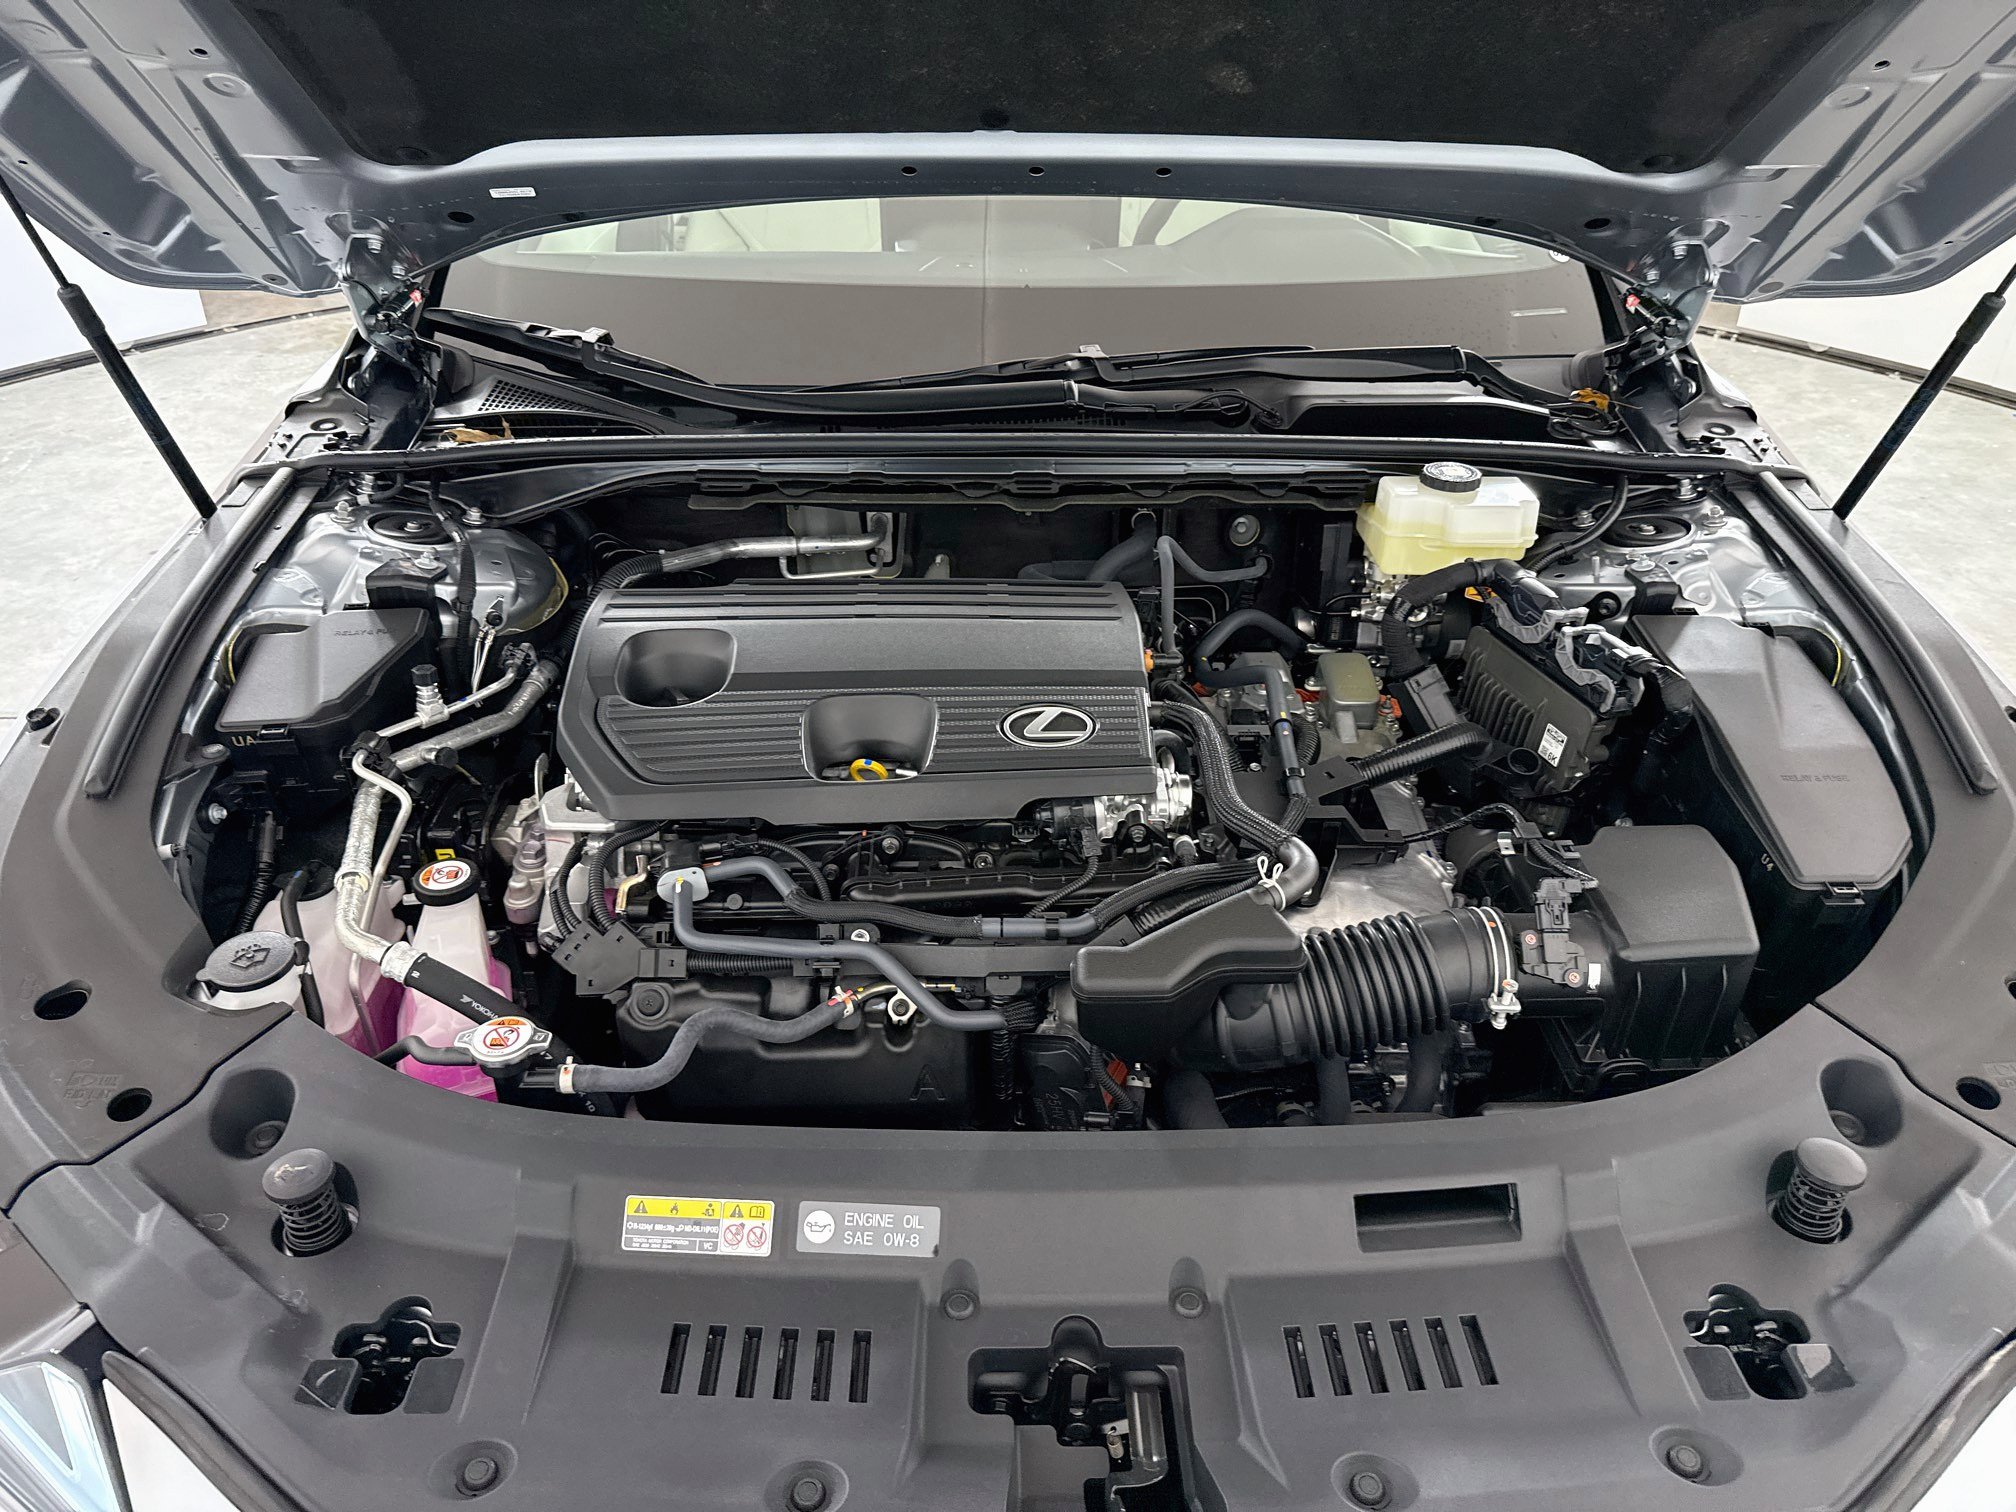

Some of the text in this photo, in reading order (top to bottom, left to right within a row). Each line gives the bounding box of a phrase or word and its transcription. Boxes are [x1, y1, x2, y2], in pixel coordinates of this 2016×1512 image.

[1547, 752, 1558, 765] 6K
[844, 1211, 925, 1230] ENGINE OIL
[703, 1241, 714, 1250] VC
[843, 1230, 920, 1248] SAE 0W-8
